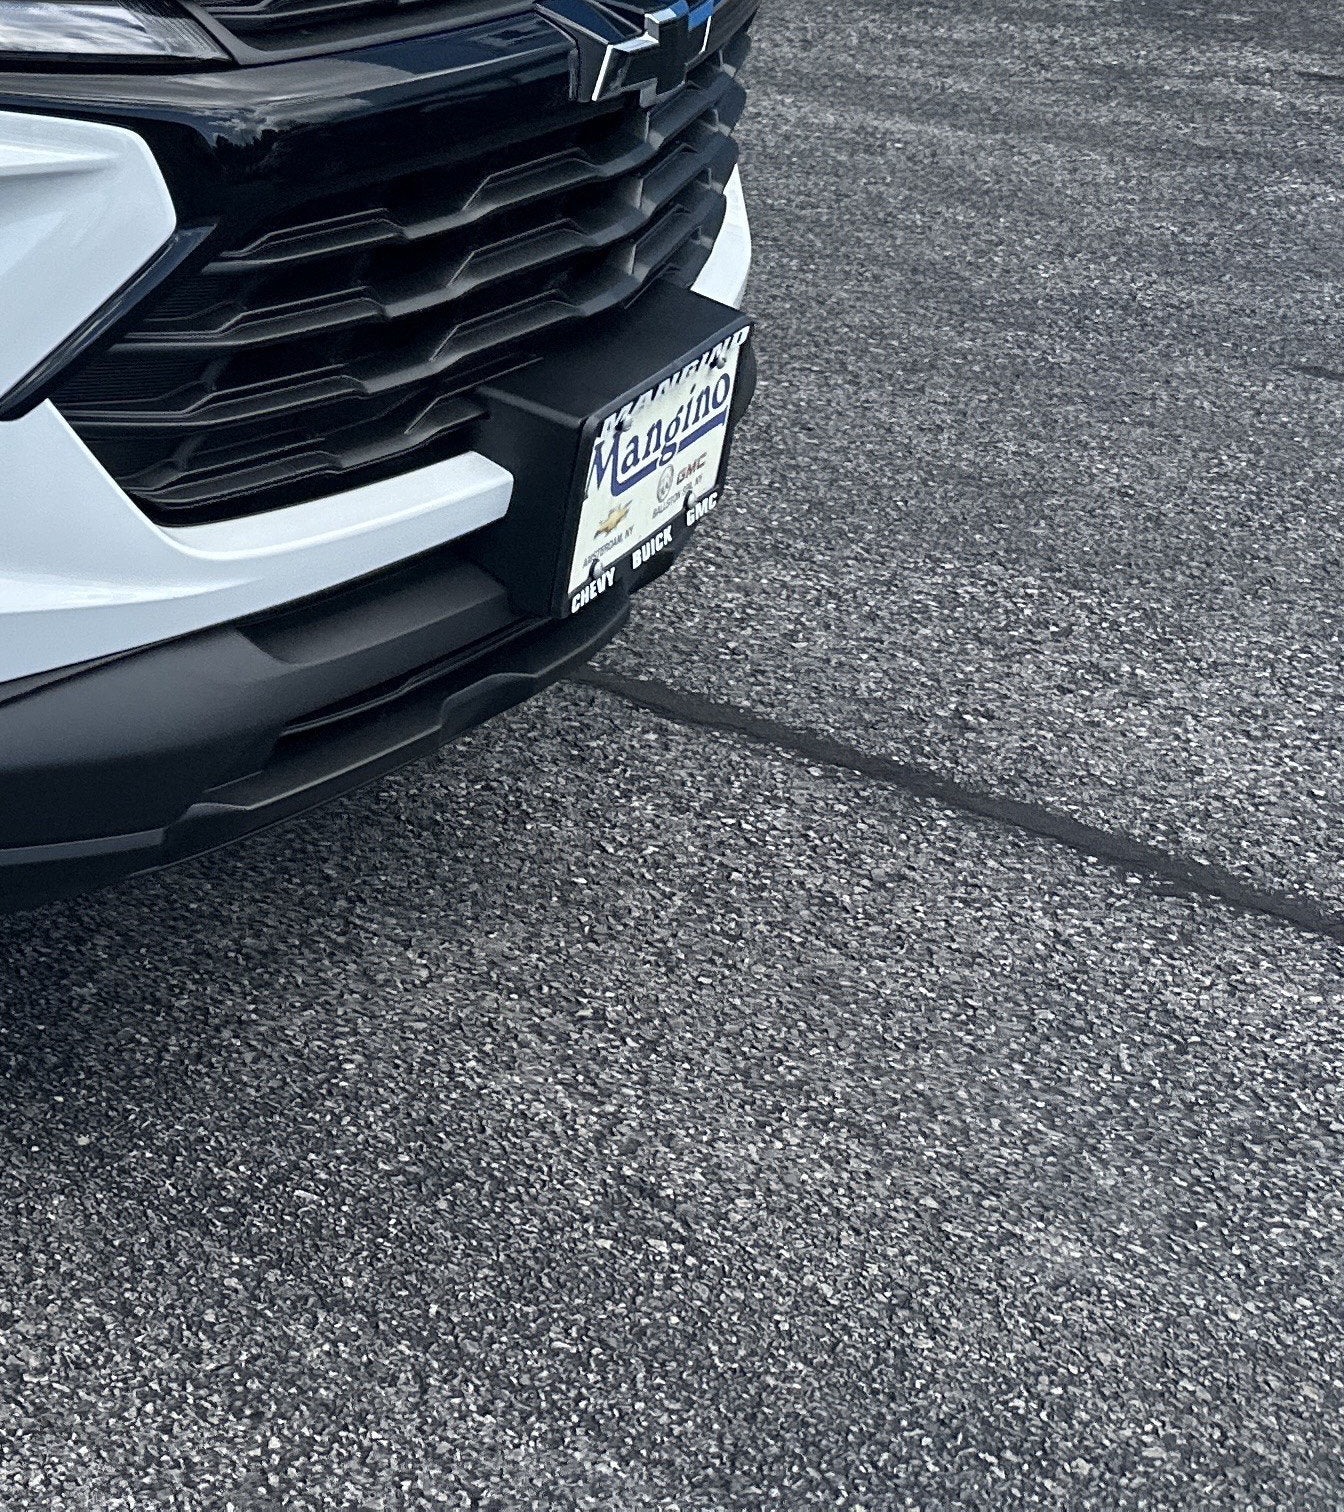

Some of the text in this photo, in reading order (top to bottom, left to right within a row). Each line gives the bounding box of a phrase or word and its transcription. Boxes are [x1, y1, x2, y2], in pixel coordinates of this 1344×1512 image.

[586, 372, 731, 497] Mangino
[676, 453, 707, 485] GMC
[571, 492, 718, 614] CHEVY BUICK GMC
